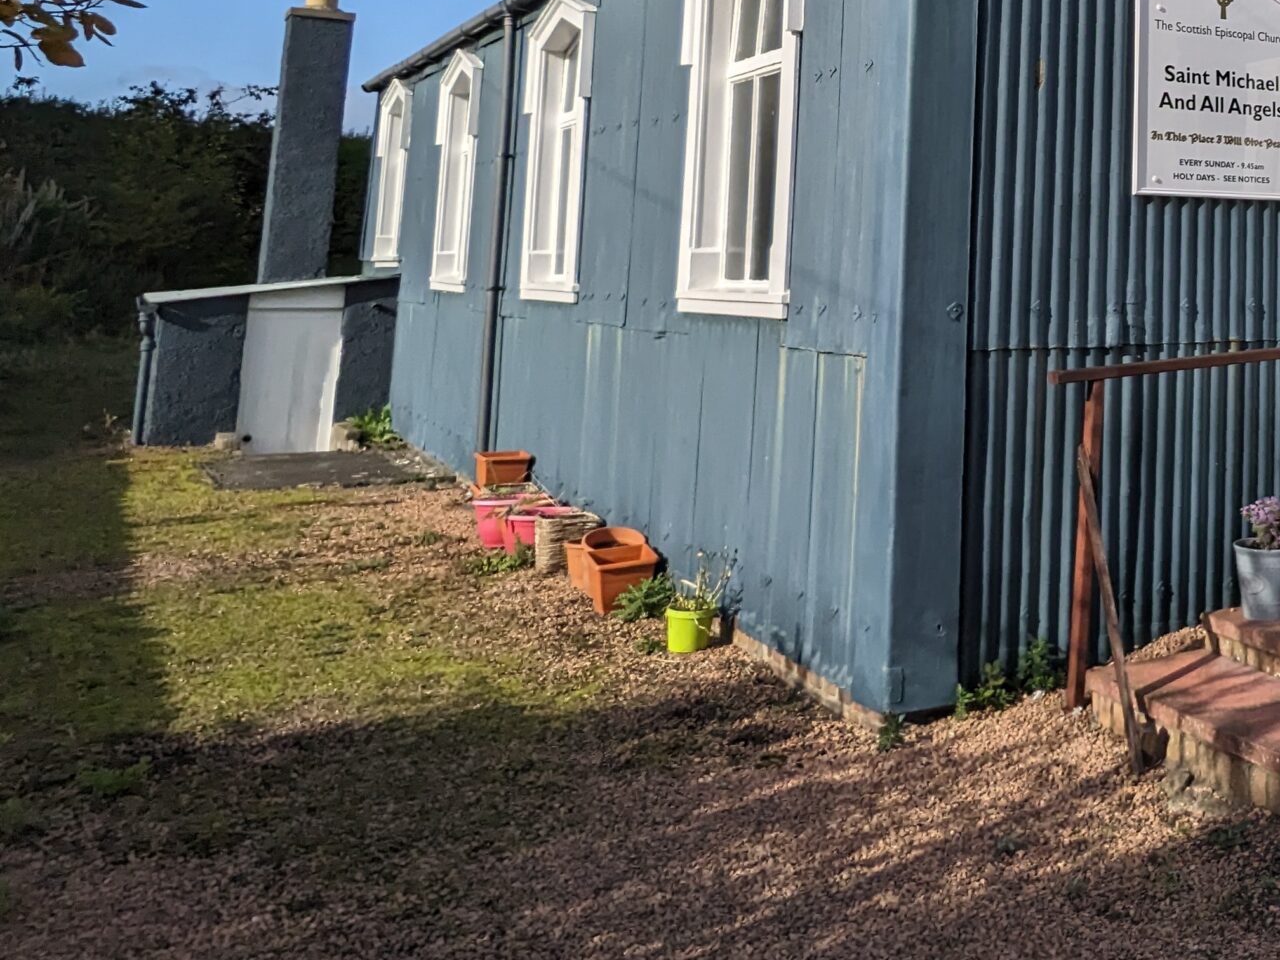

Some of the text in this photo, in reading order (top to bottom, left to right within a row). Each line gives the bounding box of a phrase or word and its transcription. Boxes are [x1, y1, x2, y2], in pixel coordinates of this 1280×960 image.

[1154, 19, 1173, 31] The
[1175, 22, 1212, 36] Scottish
[1215, 27, 1255, 41] Episcopal
[1164, 65, 1279, 91] Saint Michael
[1158, 92, 1196, 110] And
[1199, 95, 1224, 113] All
[1151, 131, 1163, 140] In
[1164, 131, 1187, 142] This
[1189, 133, 1215, 144] Place
[1223, 135, 1242, 146] Will
[1244, 137, 1263, 147] Give
[1204, 160, 1235, 169] SUNDAY
[1196, 174, 1216, 182] DAYS
[1223, 175, 1236, 183] SEE
[1238, 176, 1270, 184] NOTICES
